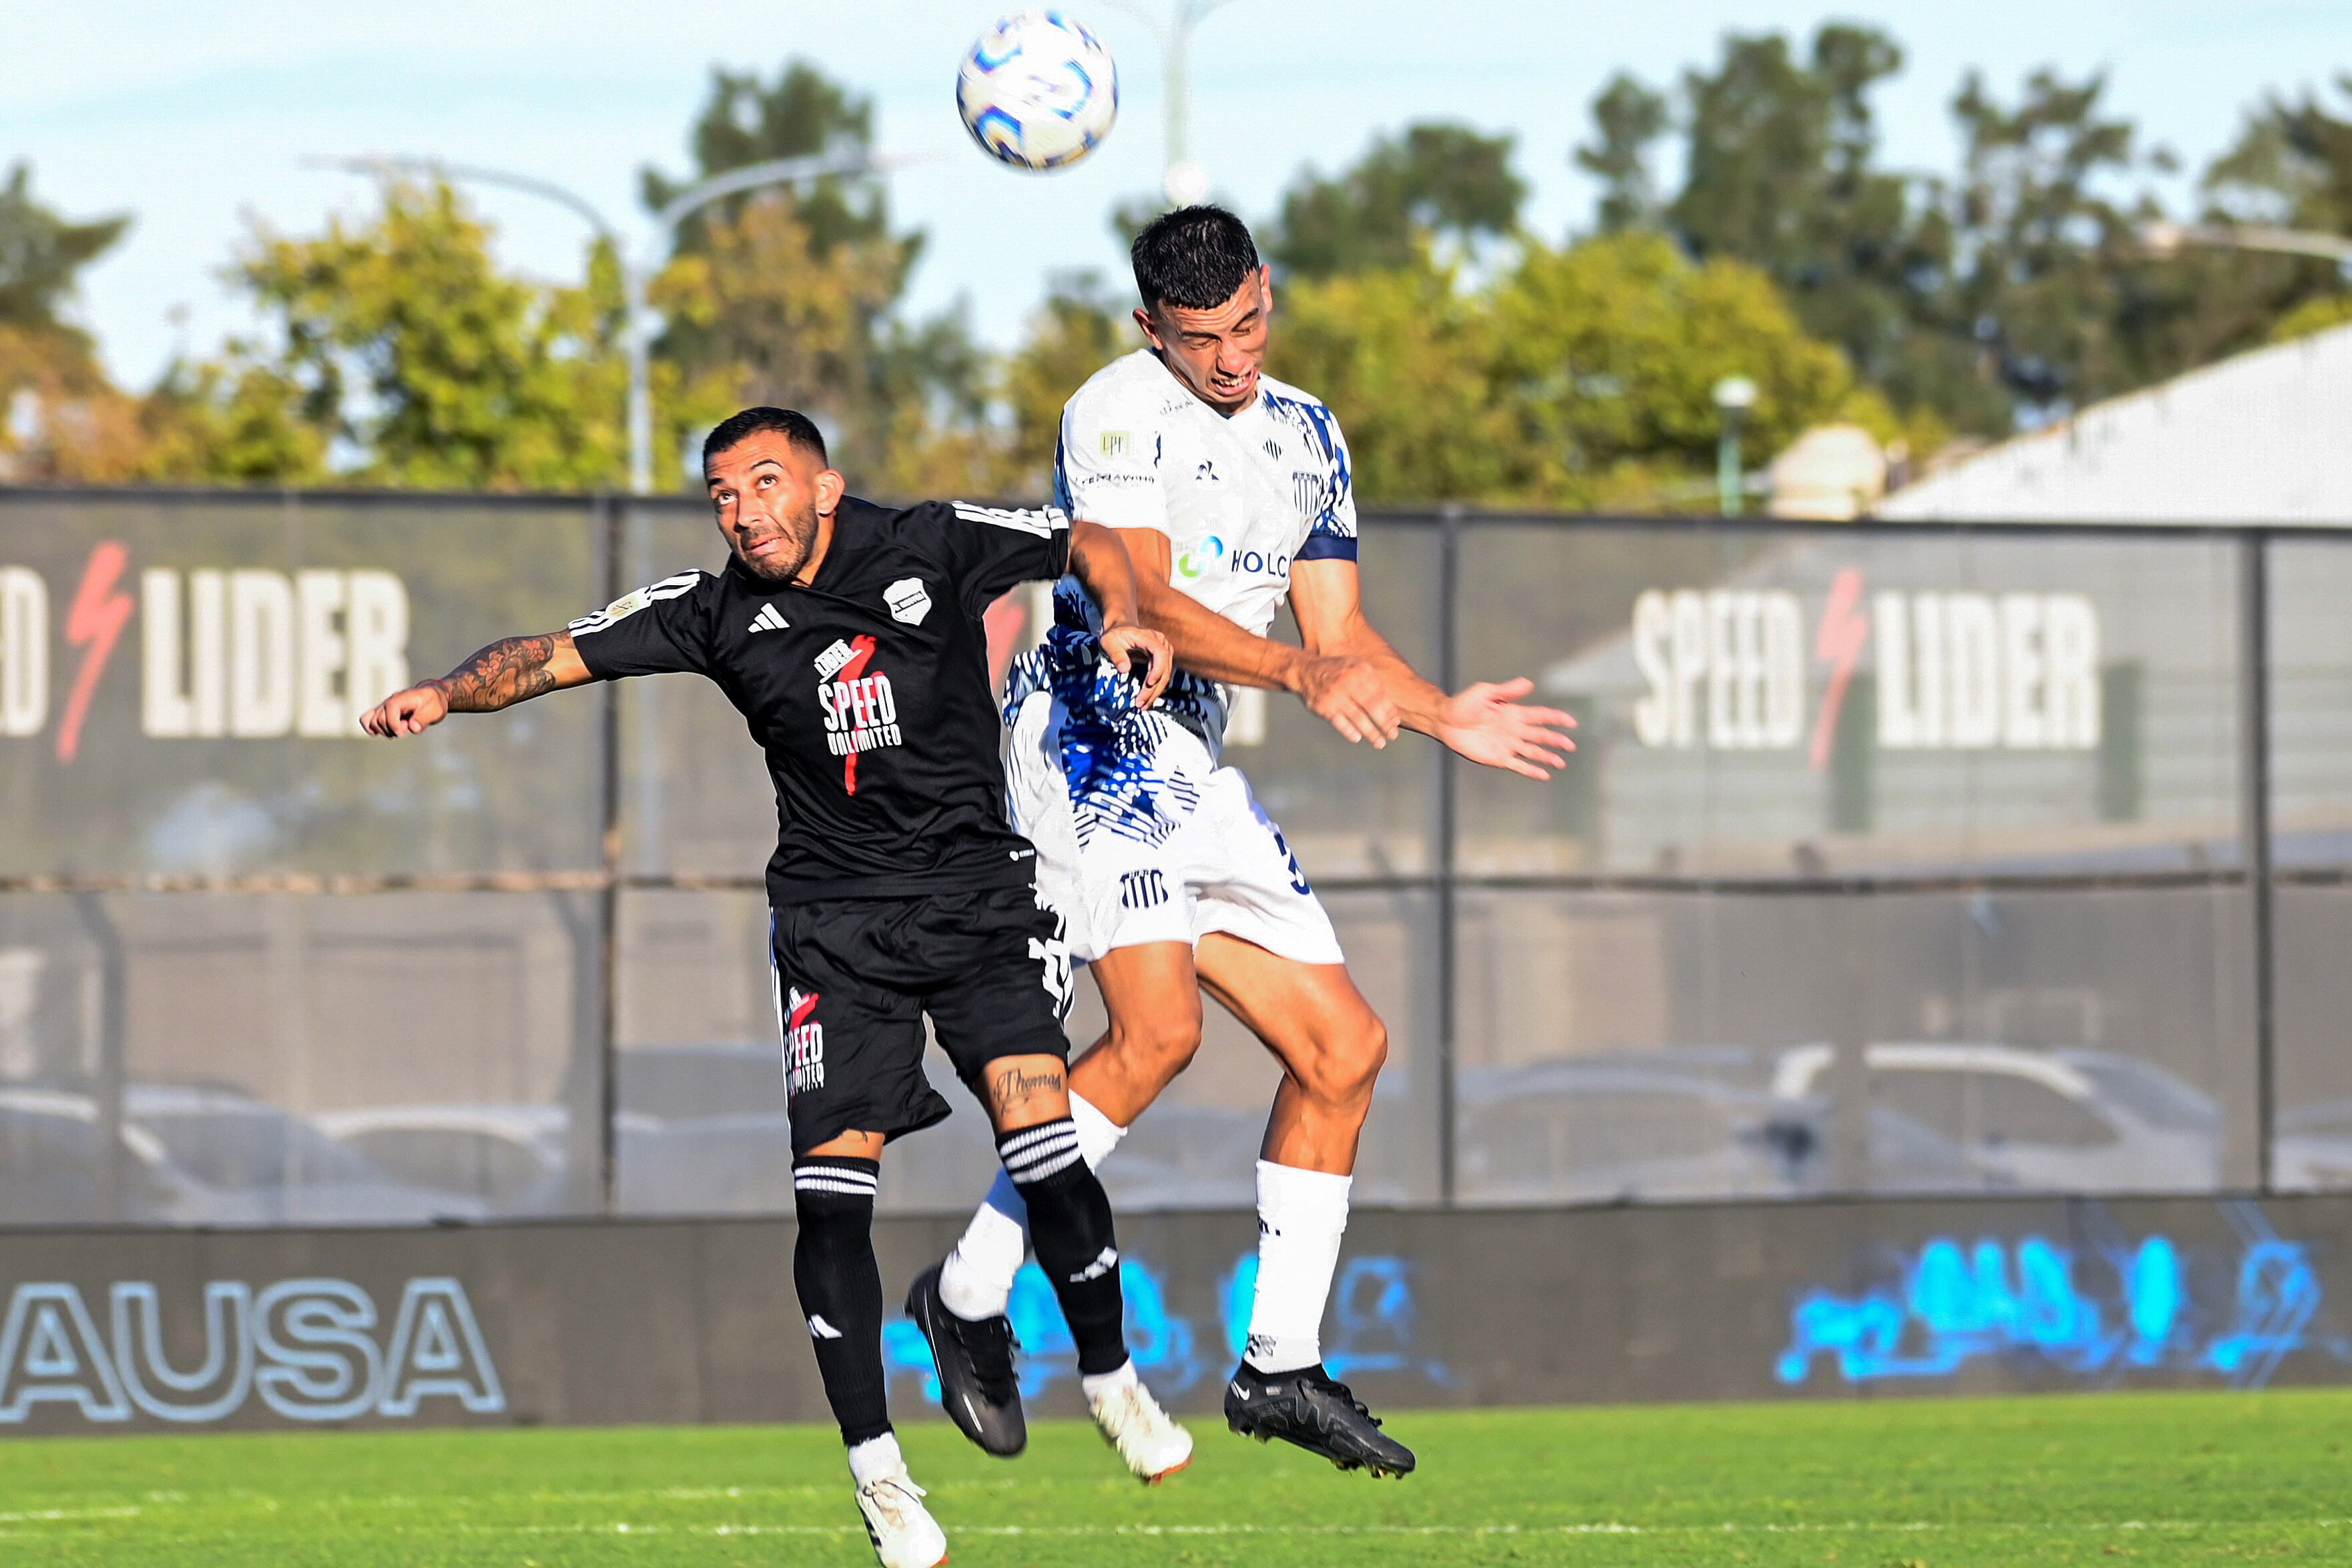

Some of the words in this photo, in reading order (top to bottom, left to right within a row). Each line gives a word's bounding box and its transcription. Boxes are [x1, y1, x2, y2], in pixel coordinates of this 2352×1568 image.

[141, 566, 410, 739] LIDER
[818, 675, 896, 732] SPEED
[1633, 587, 1803, 751] SPEED
[1873, 589, 2102, 751] LIDER
[827, 723, 902, 755] UNLIMITED
[784, 1023, 824, 1075] SPEED
[0, 1276, 507, 1423] AUSA
